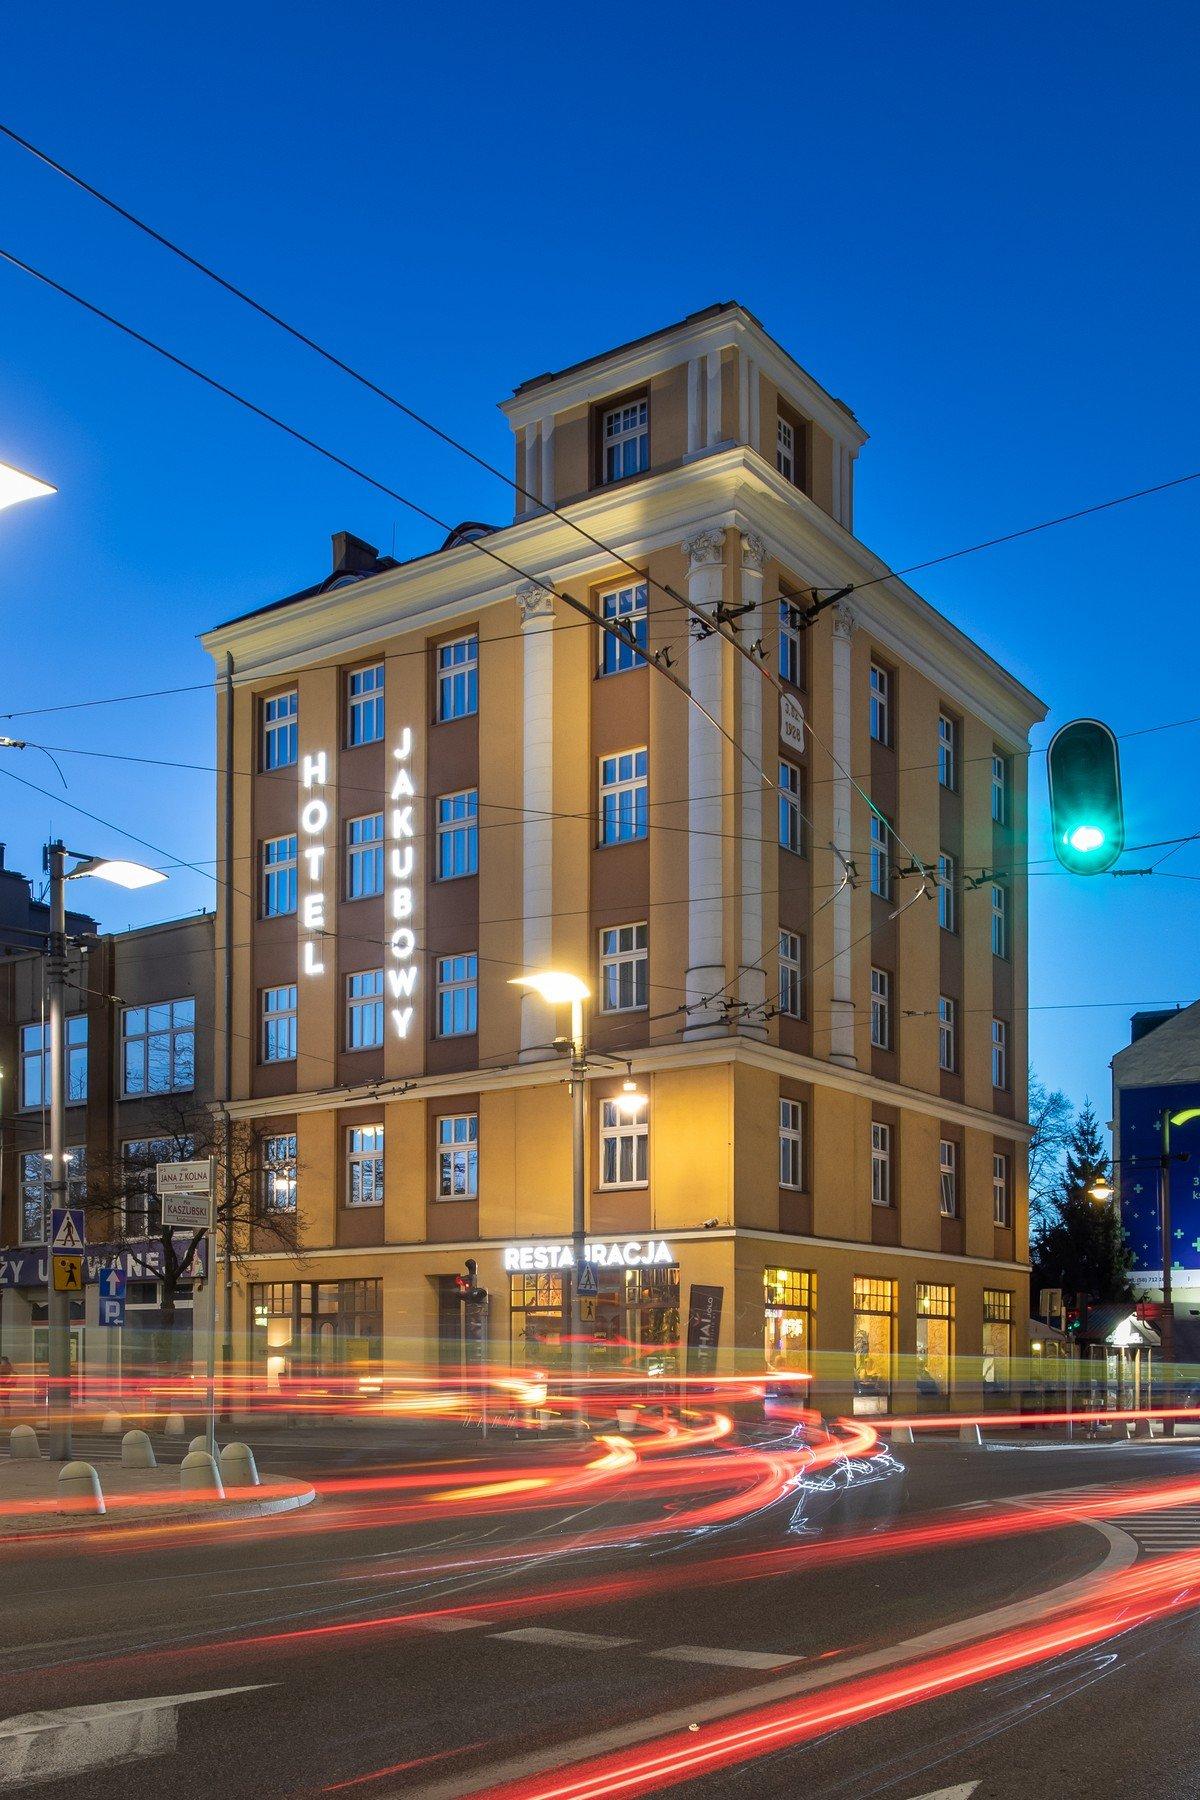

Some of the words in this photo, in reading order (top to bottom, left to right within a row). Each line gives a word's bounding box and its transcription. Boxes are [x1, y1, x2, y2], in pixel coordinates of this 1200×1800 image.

[301, 751, 328, 975] HOTEL
[388, 726, 418, 1039] JAKUBOWY
[161, 1174, 177, 1183] JANA
[179, 1173, 184, 1182] Z
[185, 1172, 208, 1182] KOLNA
[167, 1205, 208, 1216] KASZUBSKI
[106, 1301, 120, 1323] P
[698, 1318, 711, 1358] THAI
